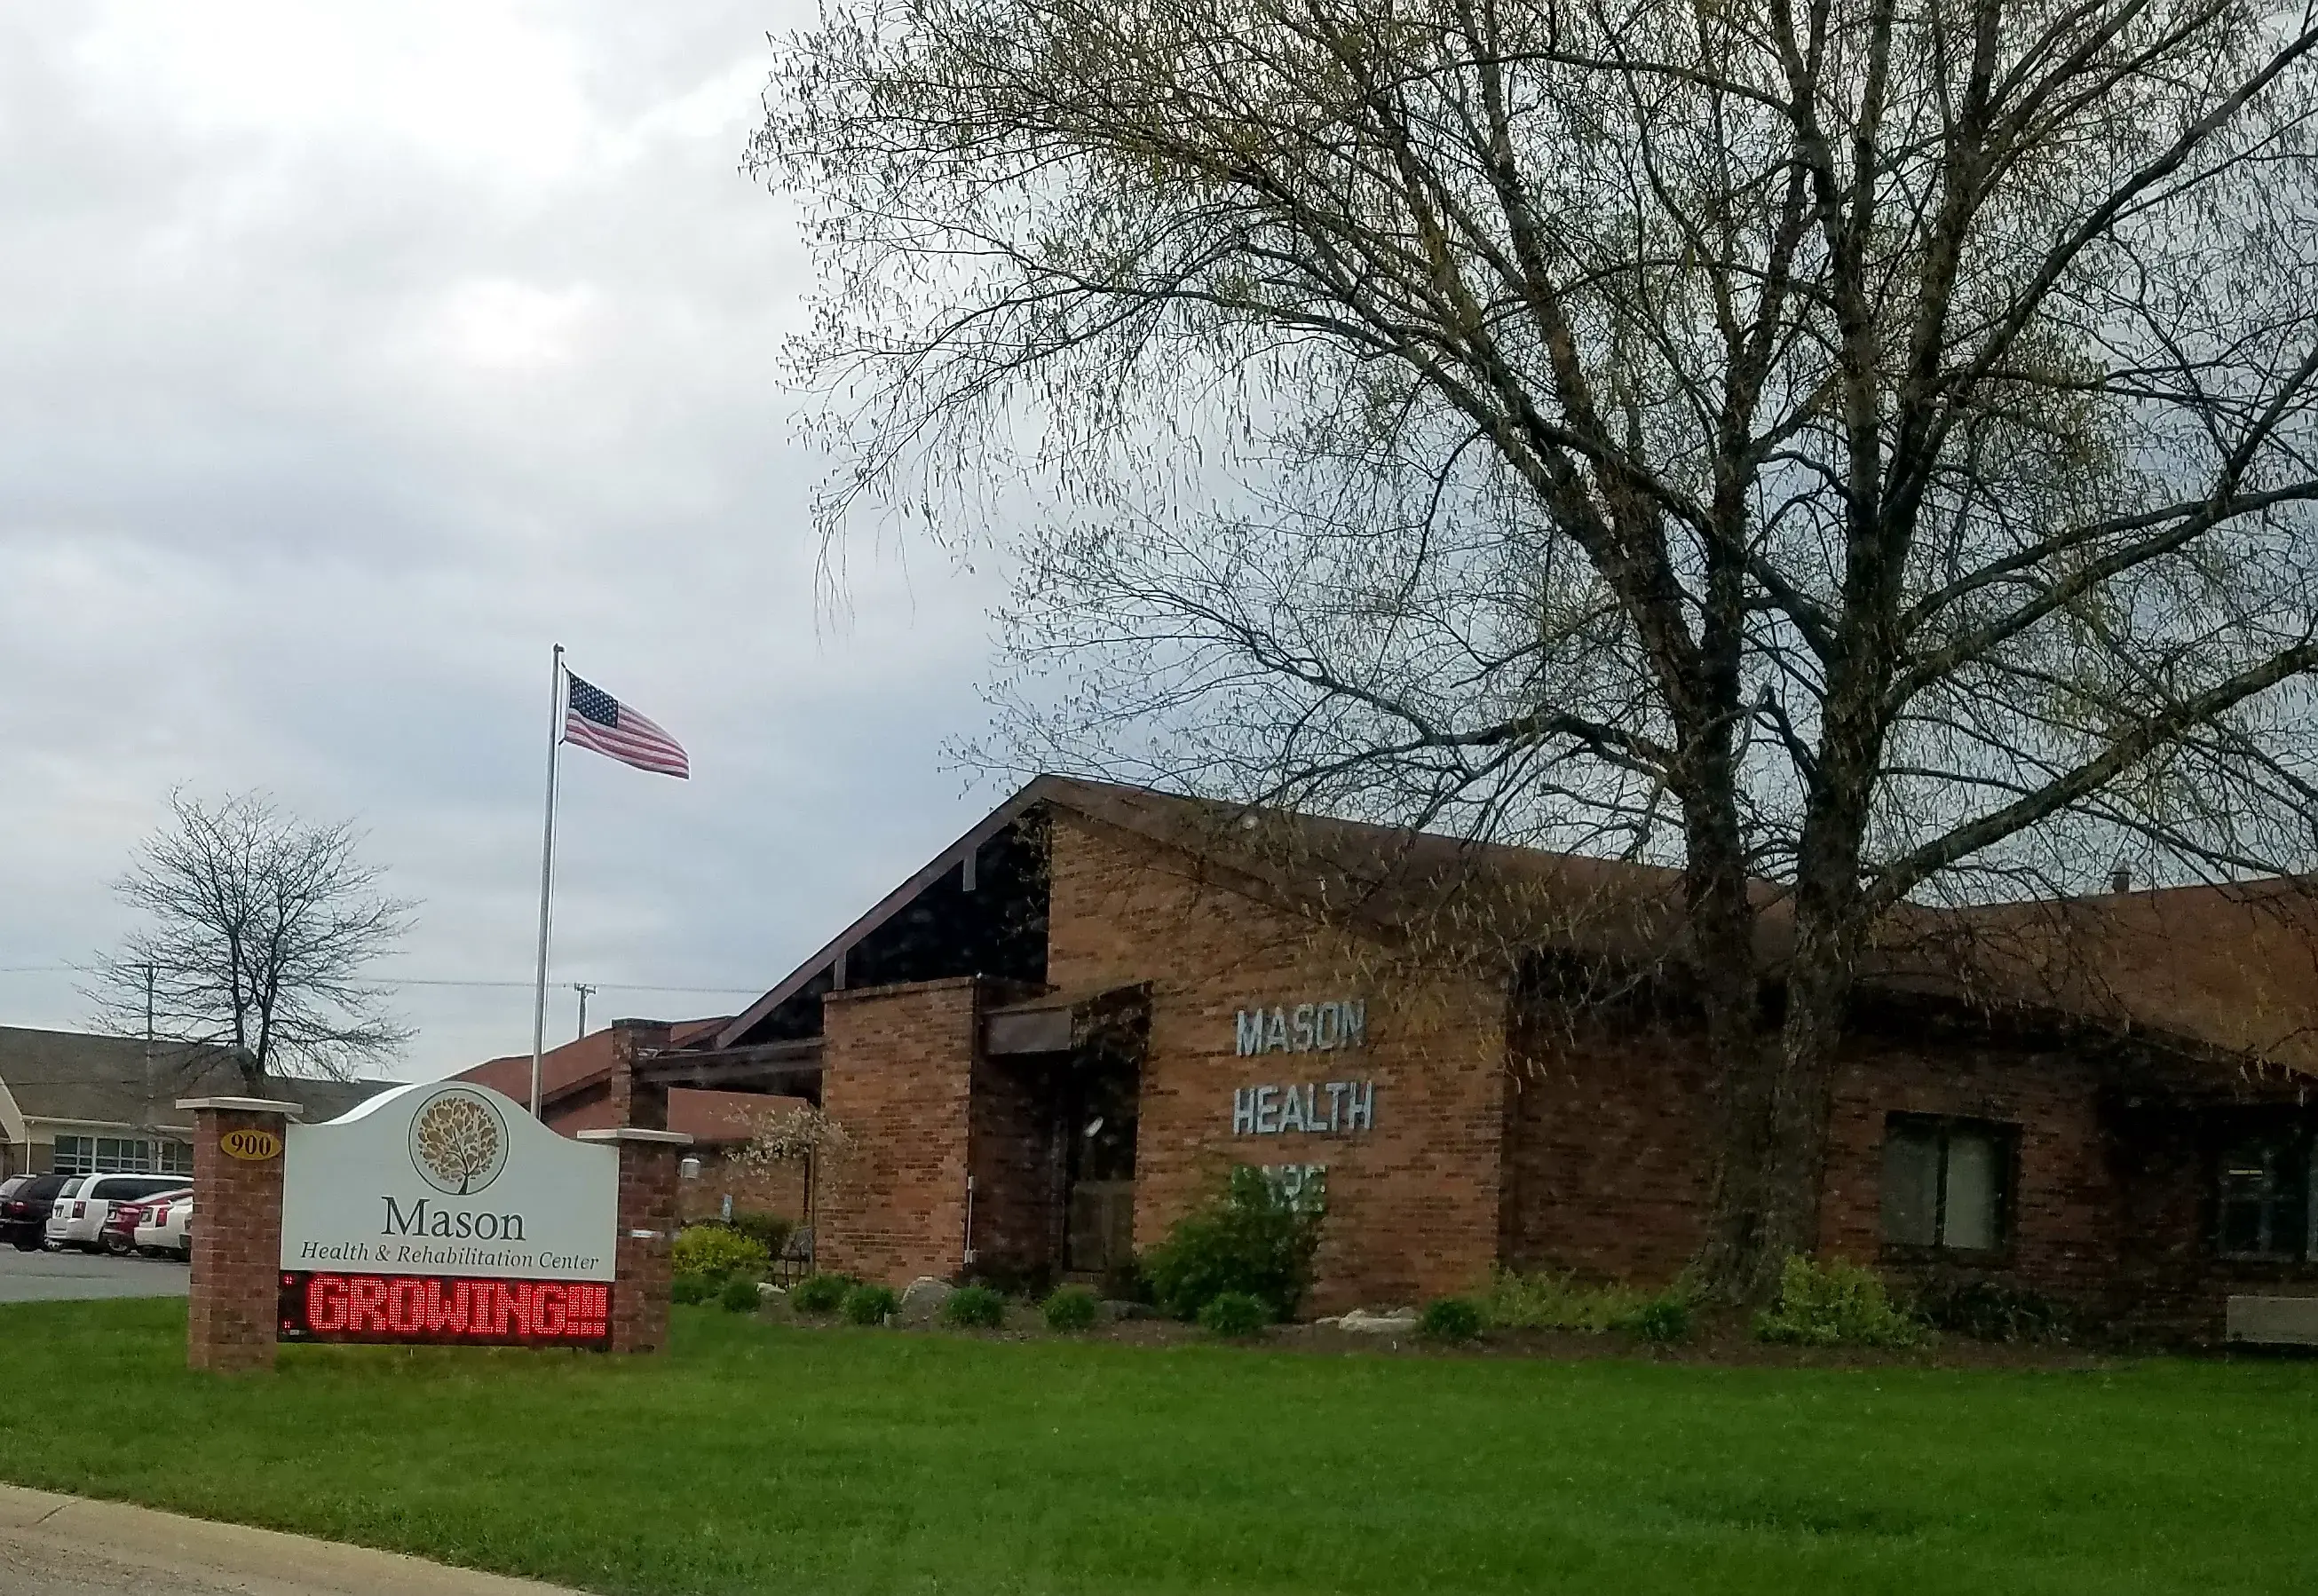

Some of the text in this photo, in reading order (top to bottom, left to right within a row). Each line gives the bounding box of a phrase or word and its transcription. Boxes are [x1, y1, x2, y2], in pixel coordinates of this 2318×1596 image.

[1236, 999, 1365, 1056] MASON
[1233, 1079, 1373, 1134] HEALTH
[231, 1134, 272, 1156] 900
[380, 1196, 526, 1242] Mason
[301, 1241, 600, 1270] Health & Rehabilitation Center
[309, 1277, 607, 1336] GROWING!!!
